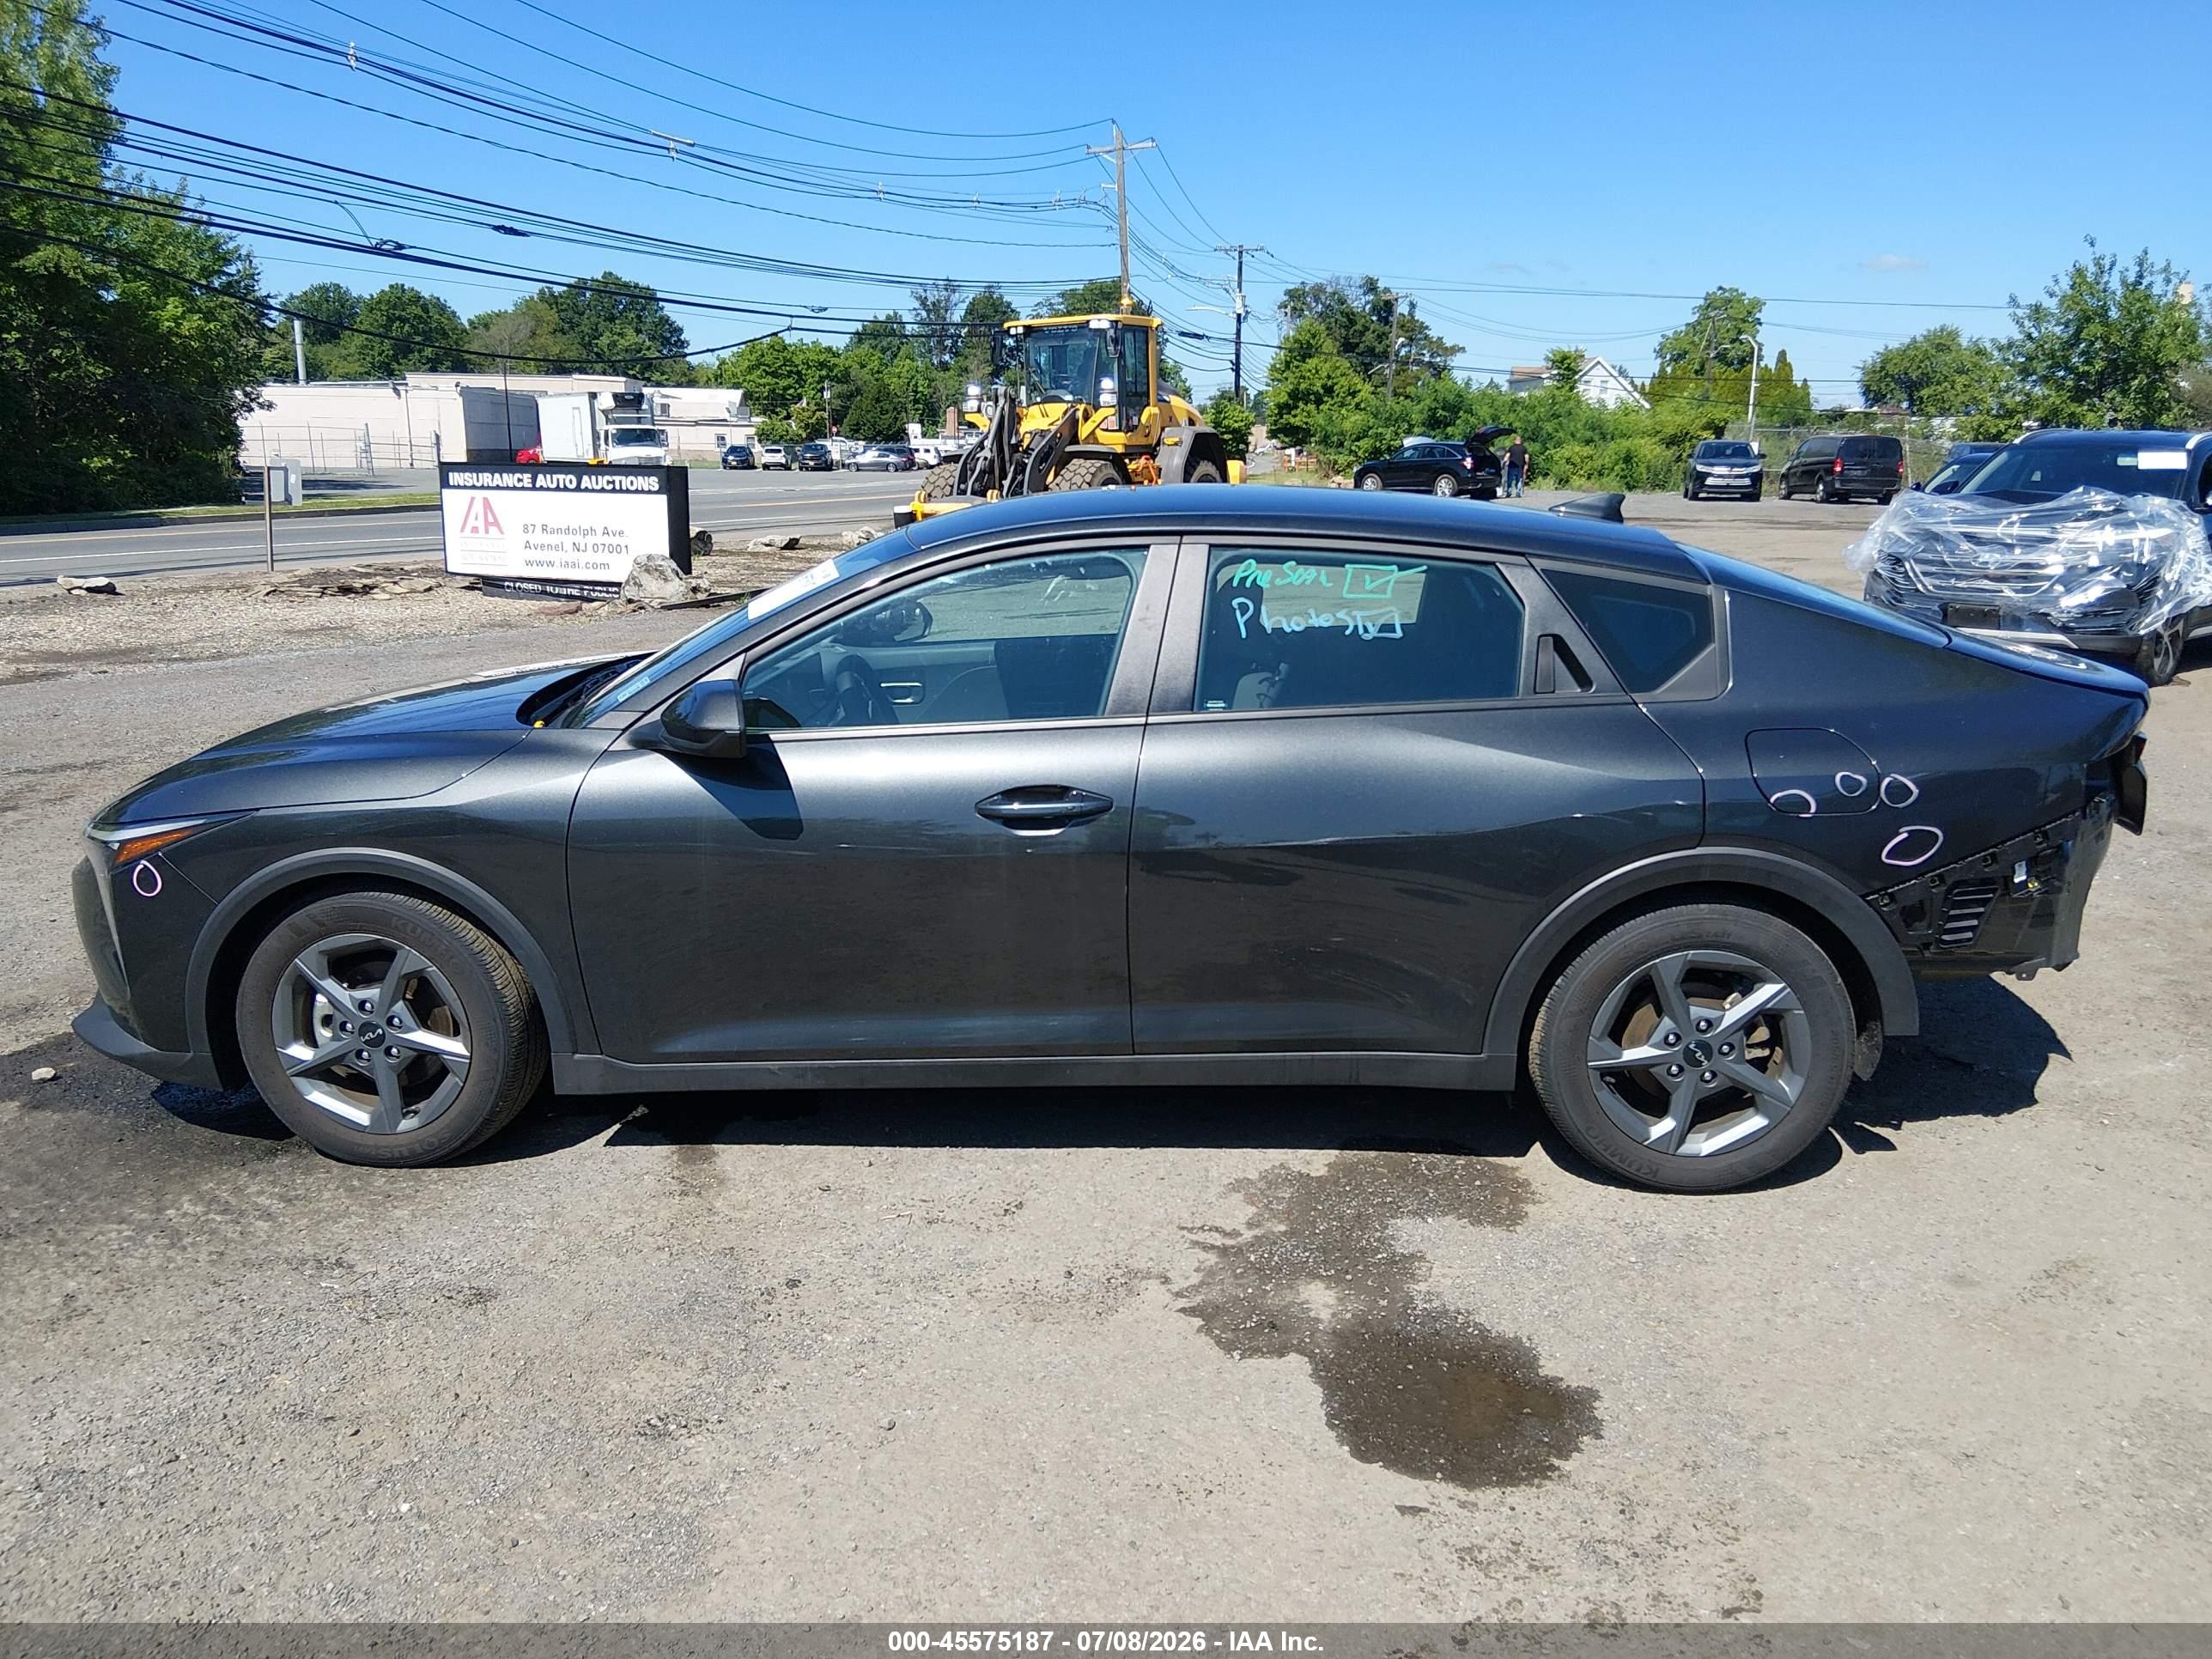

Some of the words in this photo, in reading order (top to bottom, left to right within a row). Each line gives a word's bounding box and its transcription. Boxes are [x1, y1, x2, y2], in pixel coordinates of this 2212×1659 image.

[448, 471, 532, 488] INSURANCE
[535, 473, 577, 489] AUTO
[580, 475, 659, 491] AUCTIONS
[522, 523, 536, 534] 87
[541, 524, 597, 538] Randolph
[602, 526, 629, 538] Ave.
[524, 540, 568, 553] Avenel,
[572, 542, 587, 552] NJ
[592, 543, 629, 555] 07001
[525, 558, 610, 570] www.iaai.com
[504, 581, 542, 593] CLOSED
